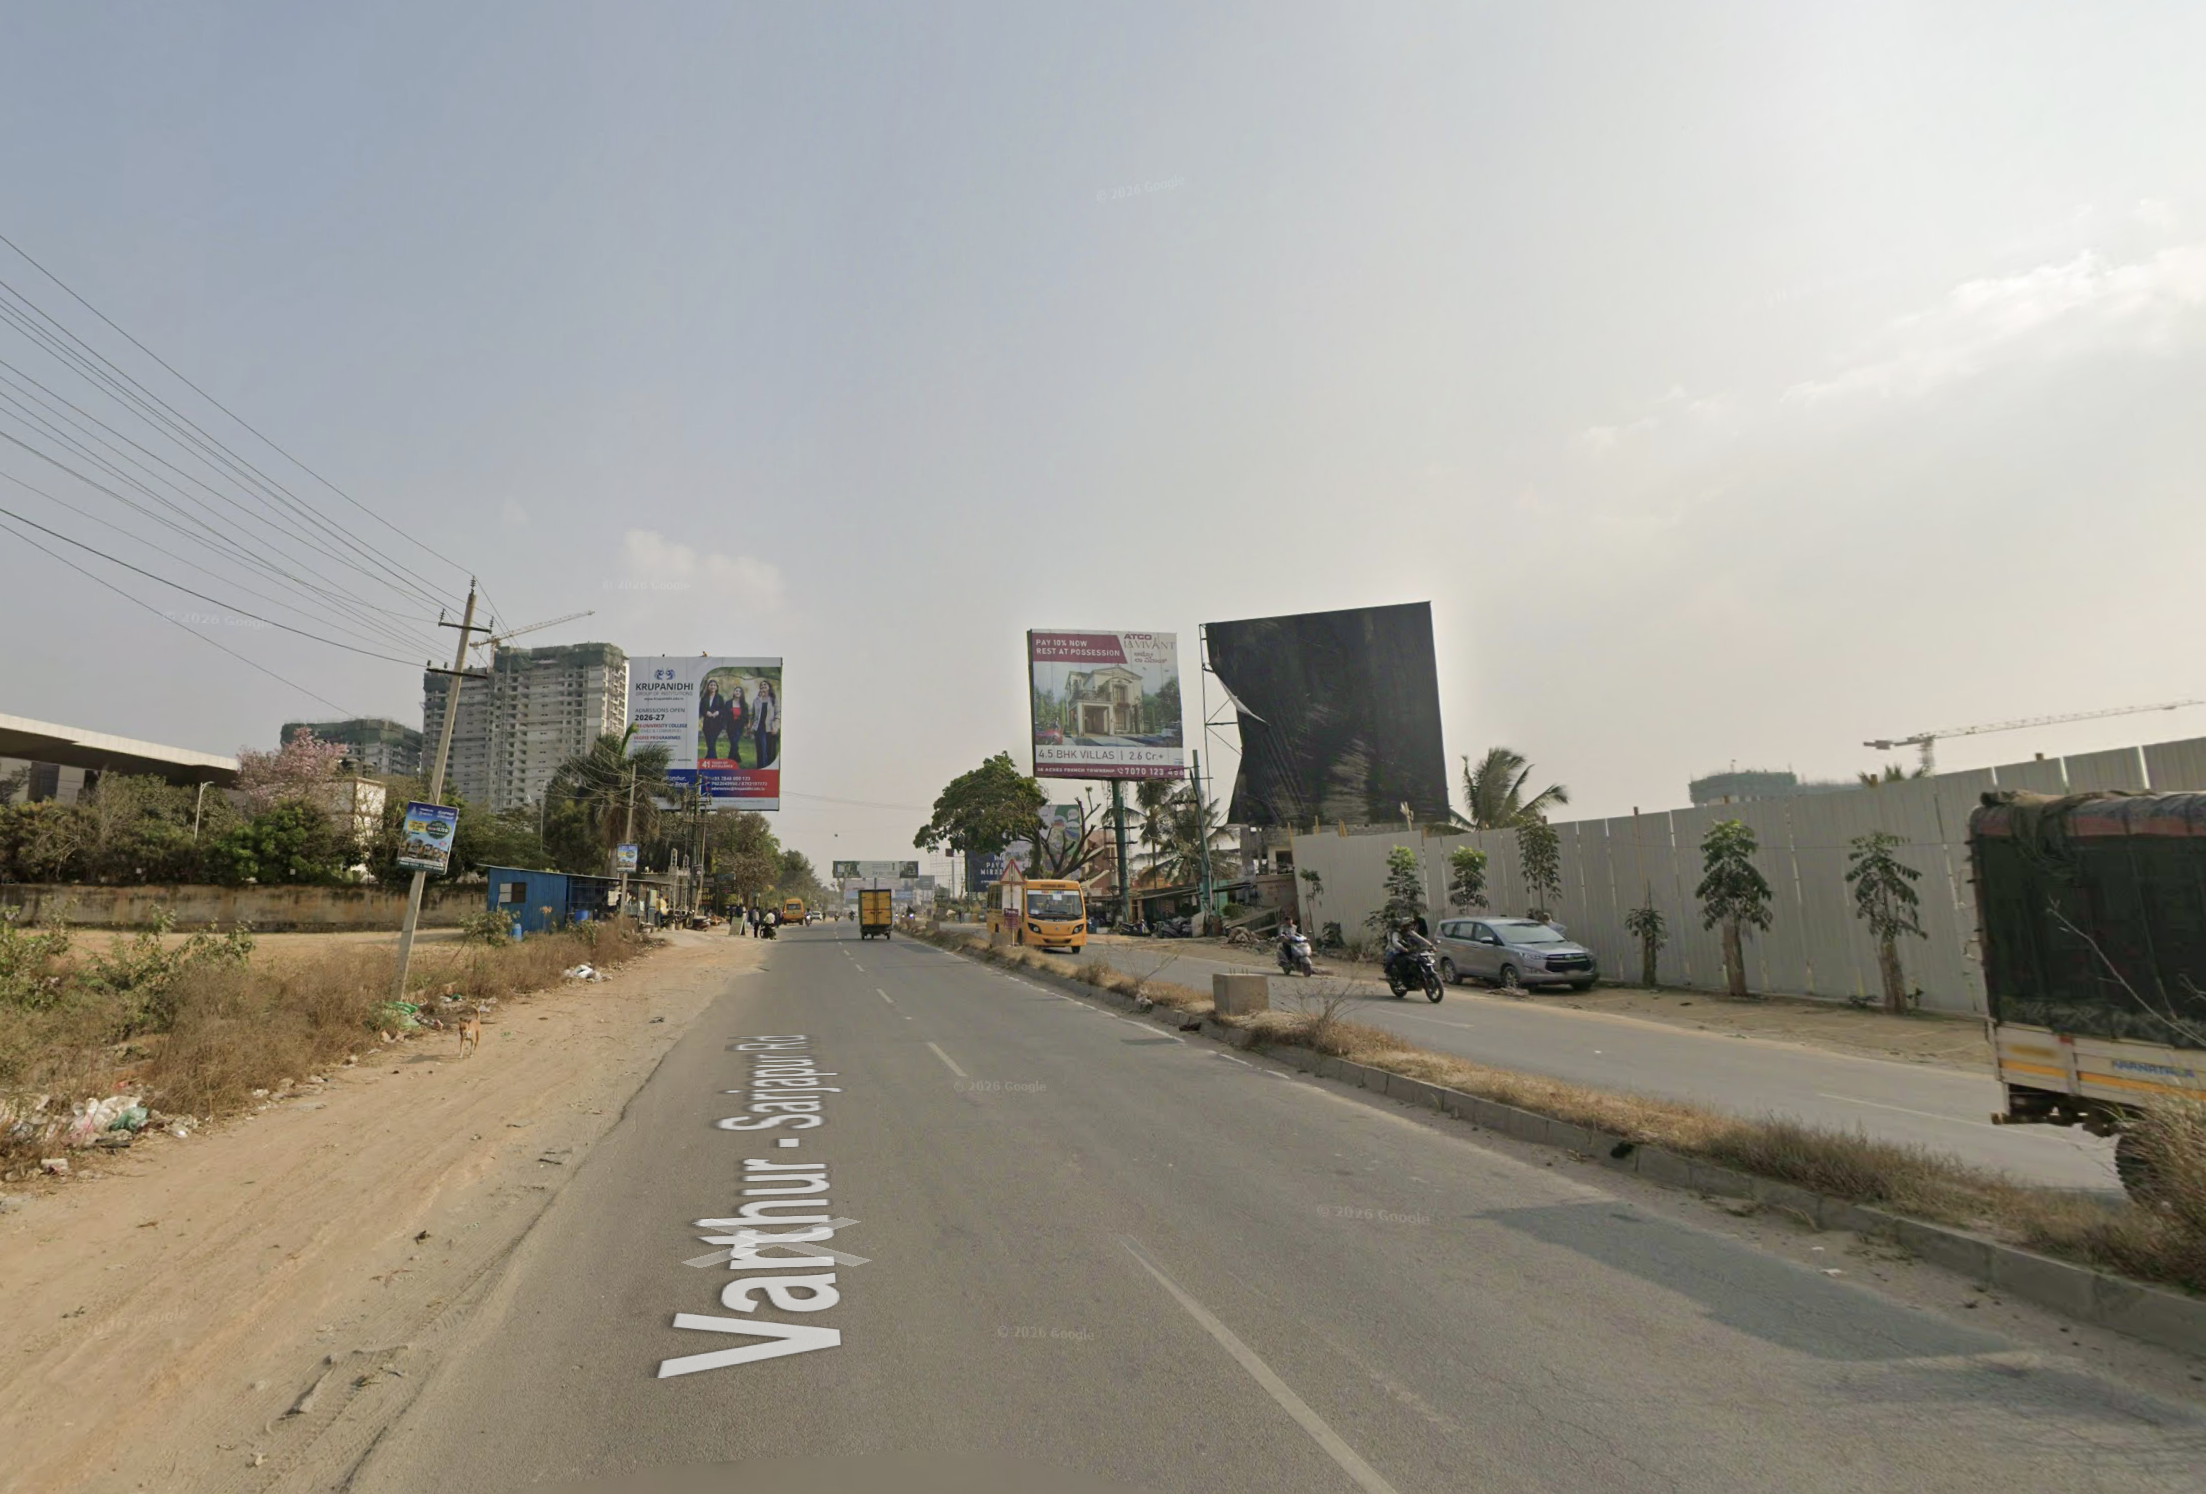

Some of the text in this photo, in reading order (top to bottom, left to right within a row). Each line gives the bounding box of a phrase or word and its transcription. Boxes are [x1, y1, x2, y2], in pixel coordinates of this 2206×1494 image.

[1036, 647, 1057, 655] REST
[1070, 649, 1120, 657] POSSESSION
[635, 682, 694, 691] KRUPANIDHI
[1038, 749, 1053, 759] 4.5
[1056, 749, 1077, 759] BHK
[1080, 750, 1115, 760] VILLAS
[1129, 751, 1143, 760] 2.6
[702, 760, 711, 768] 41
[1124, 767, 1147, 775] 7070
[1150, 768, 1164, 776] 123
